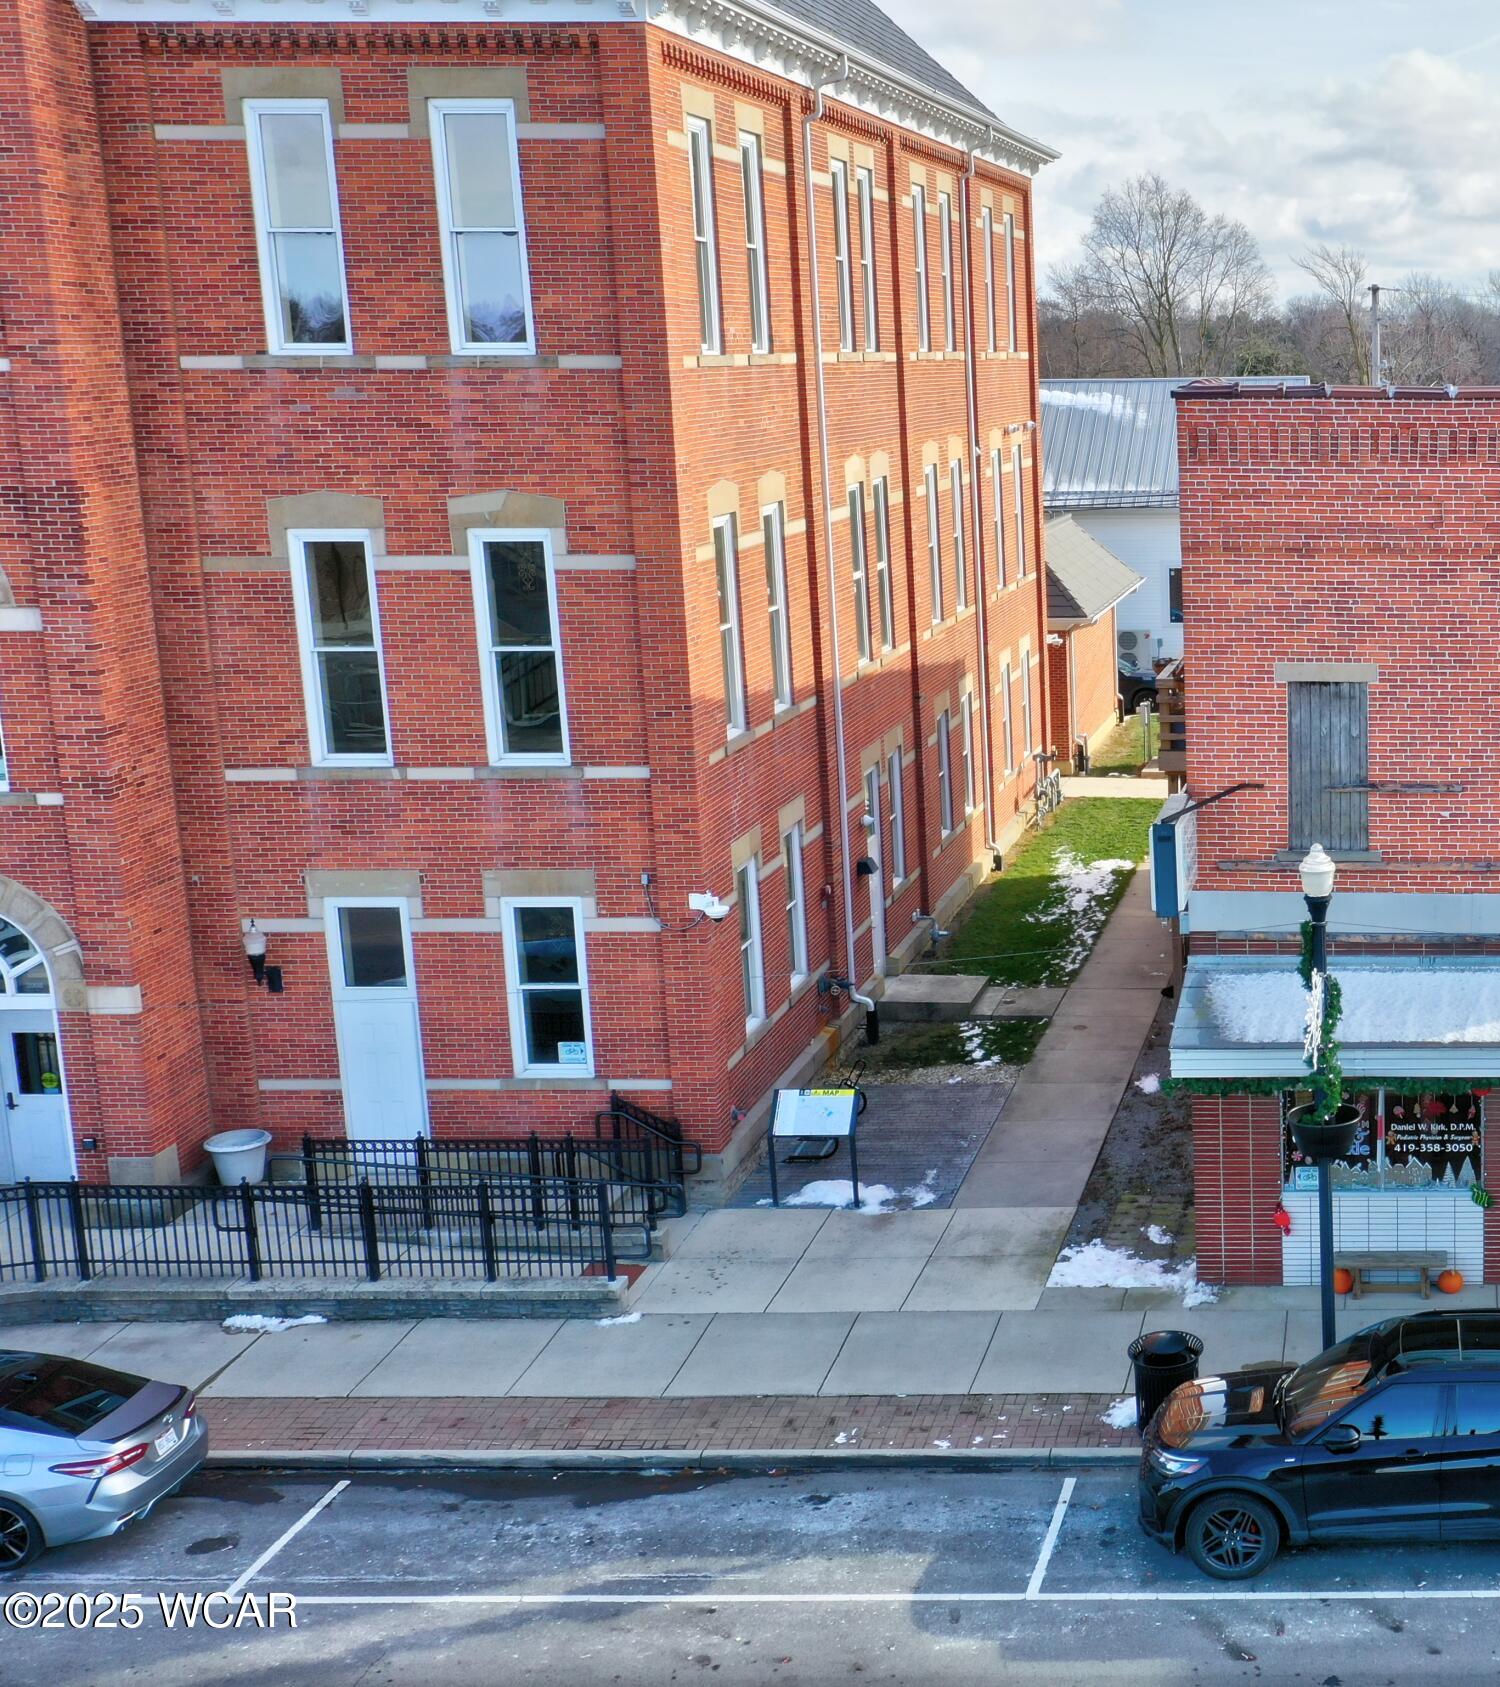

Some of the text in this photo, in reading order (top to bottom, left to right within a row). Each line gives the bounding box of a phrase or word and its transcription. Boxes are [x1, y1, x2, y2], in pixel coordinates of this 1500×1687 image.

[1390, 1123, 1416, 1131] Daniel
[1417, 1123, 1428, 1131] W.
[1450, 1123, 1476, 1131] D.P.M.
[1393, 1143, 1473, 1152] 419-358-3050
